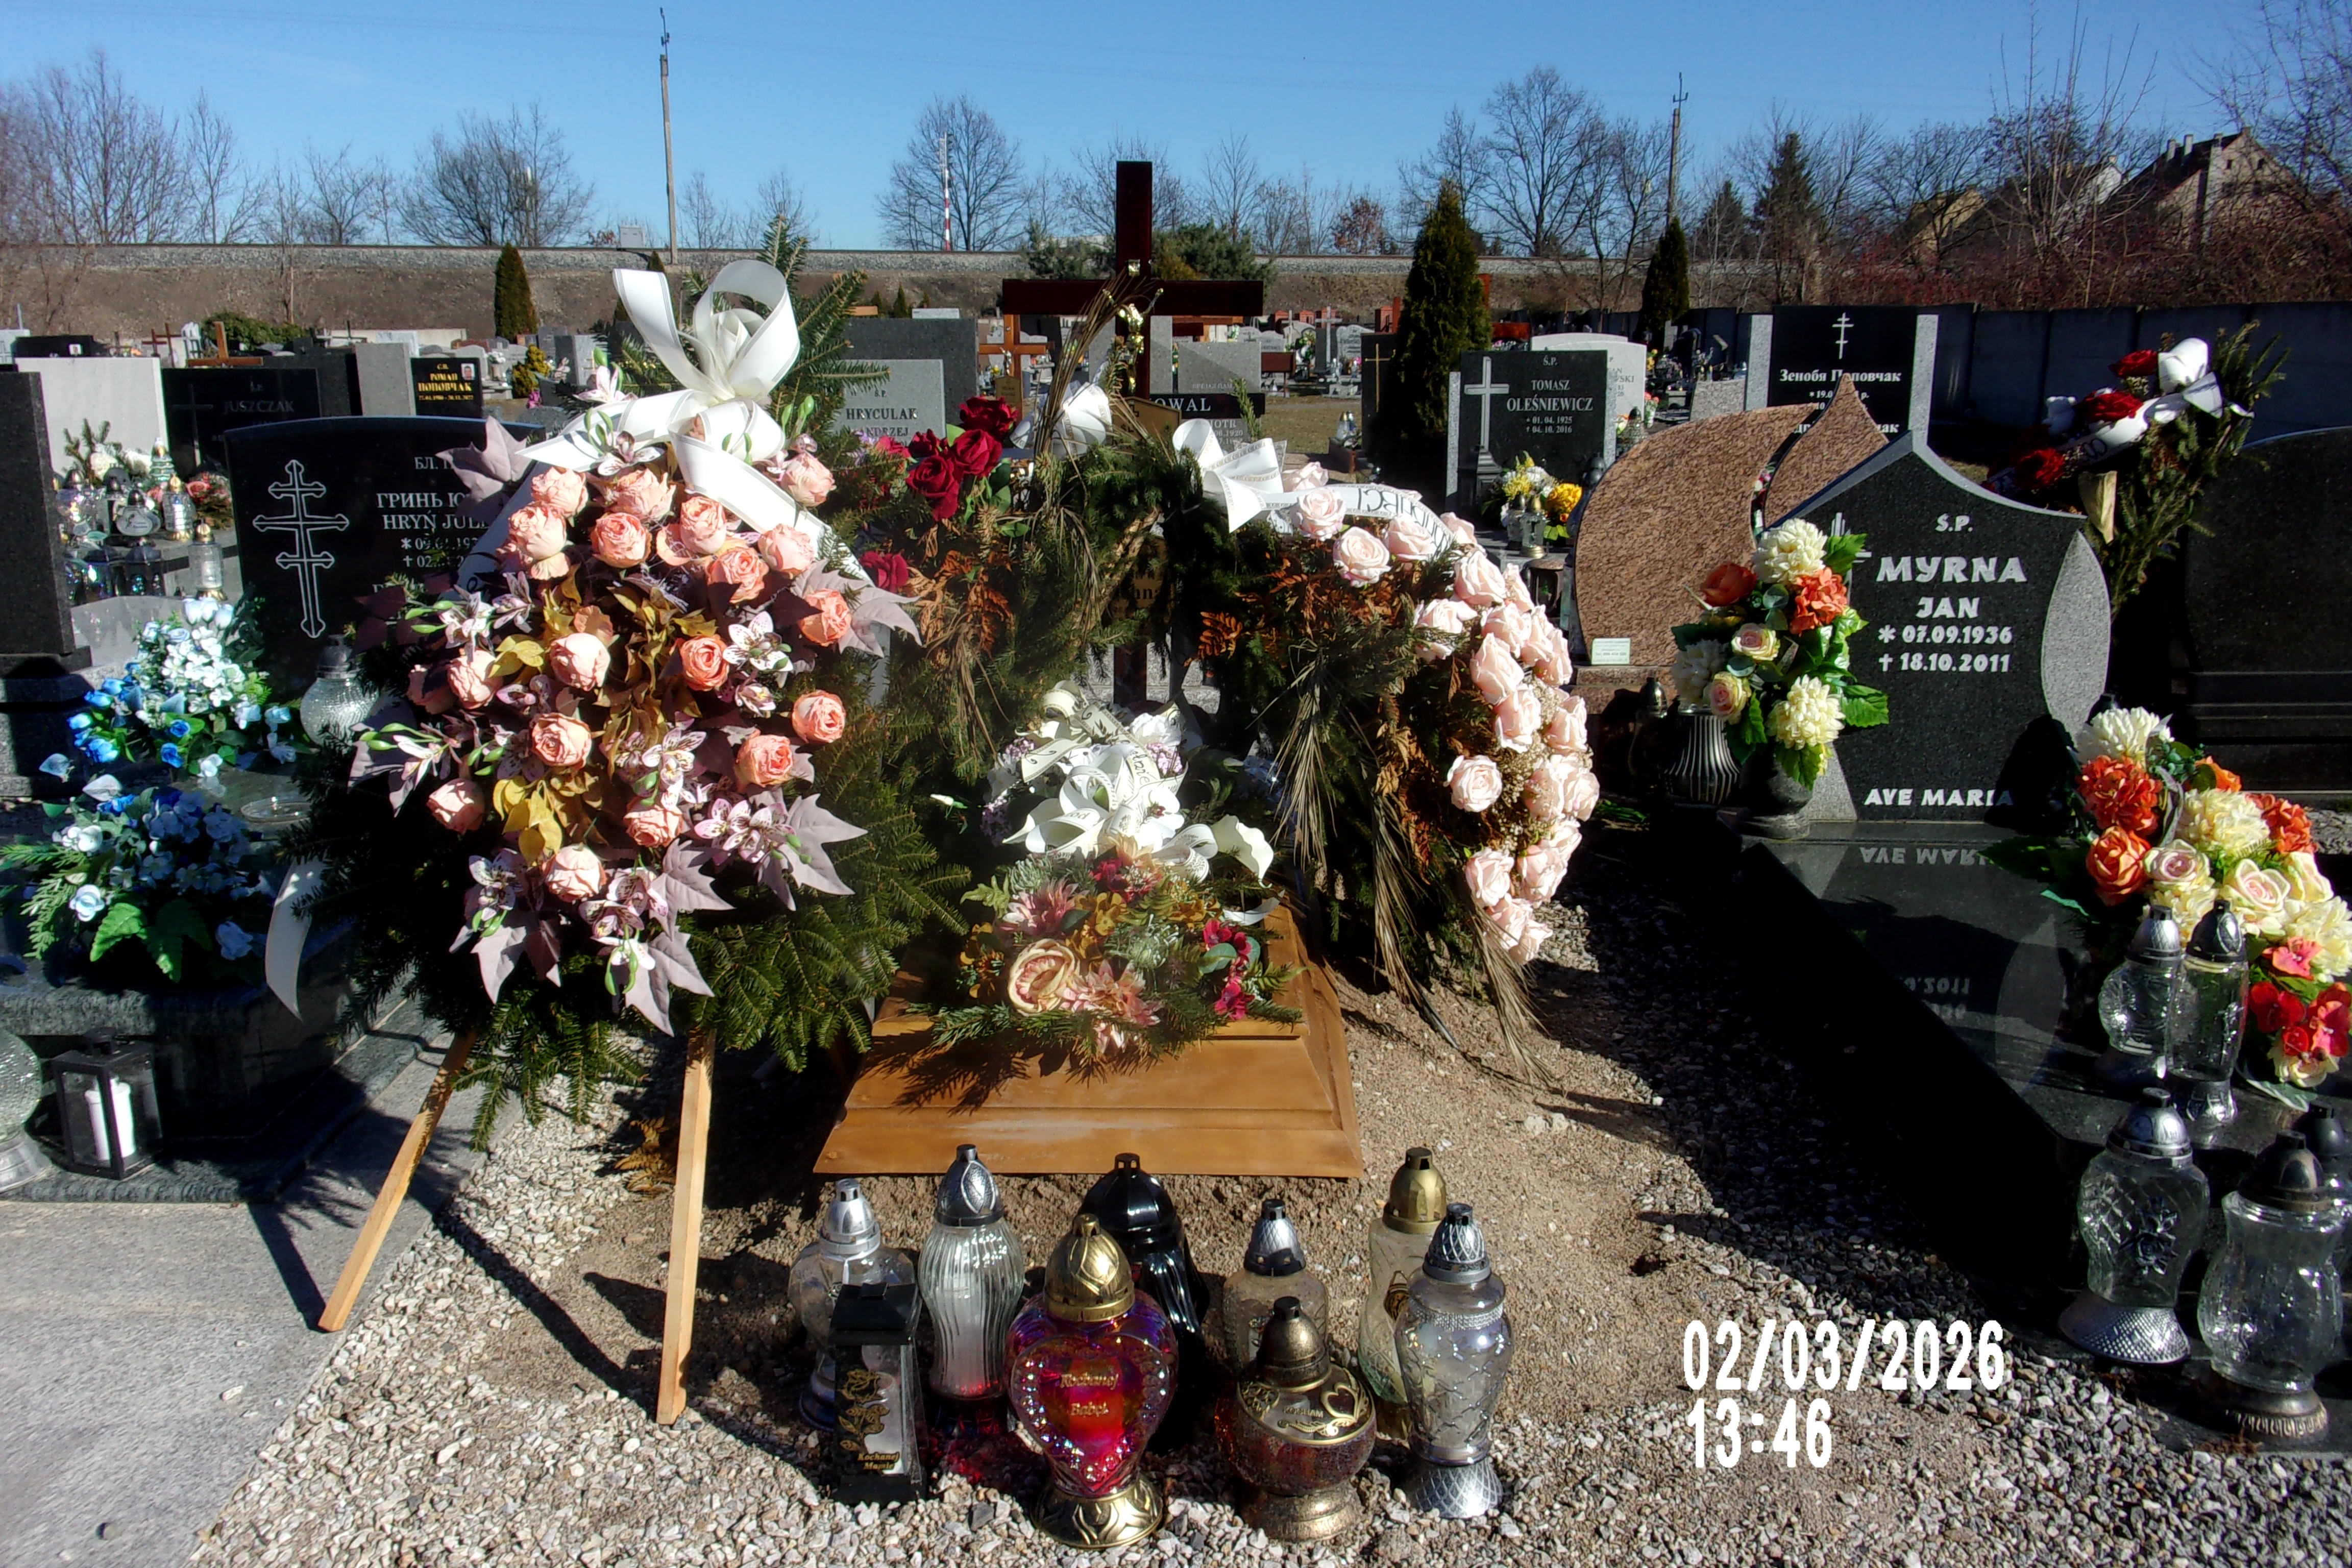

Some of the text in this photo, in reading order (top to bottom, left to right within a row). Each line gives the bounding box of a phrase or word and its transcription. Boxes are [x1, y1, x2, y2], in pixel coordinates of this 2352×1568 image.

[1779, 369, 1902, 382] Зенобя Пповчак
[1532, 380, 1571, 391] TOMASZ
[1150, 398, 1212, 412] OWAL
[1506, 394, 1594, 411] OLEŚNIEWICZ
[846, 408, 918, 420] HRYCULAK
[1210, 419, 1237, 428] IOTR
[866, 427, 909, 436] NDRZEJ
[414, 456, 438, 470] БЛ.
[376, 493, 466, 508] ГРИНЬ Ю
[382, 509, 488, 530] HRYŃ JUL
[1876, 556, 2028, 583] MYRNA
[1916, 596, 1980, 619] JAN
[1902, 625, 2013, 644] 07.09.1936
[1900, 652, 2011, 673] 18.10.2011
[1921, 789, 2014, 806] MARIA
[1060, 1371, 1119, 1390] Kochanej
[1283, 1406, 1324, 1418] KOCHAM
[858, 1452, 900, 1463] Kochanej
